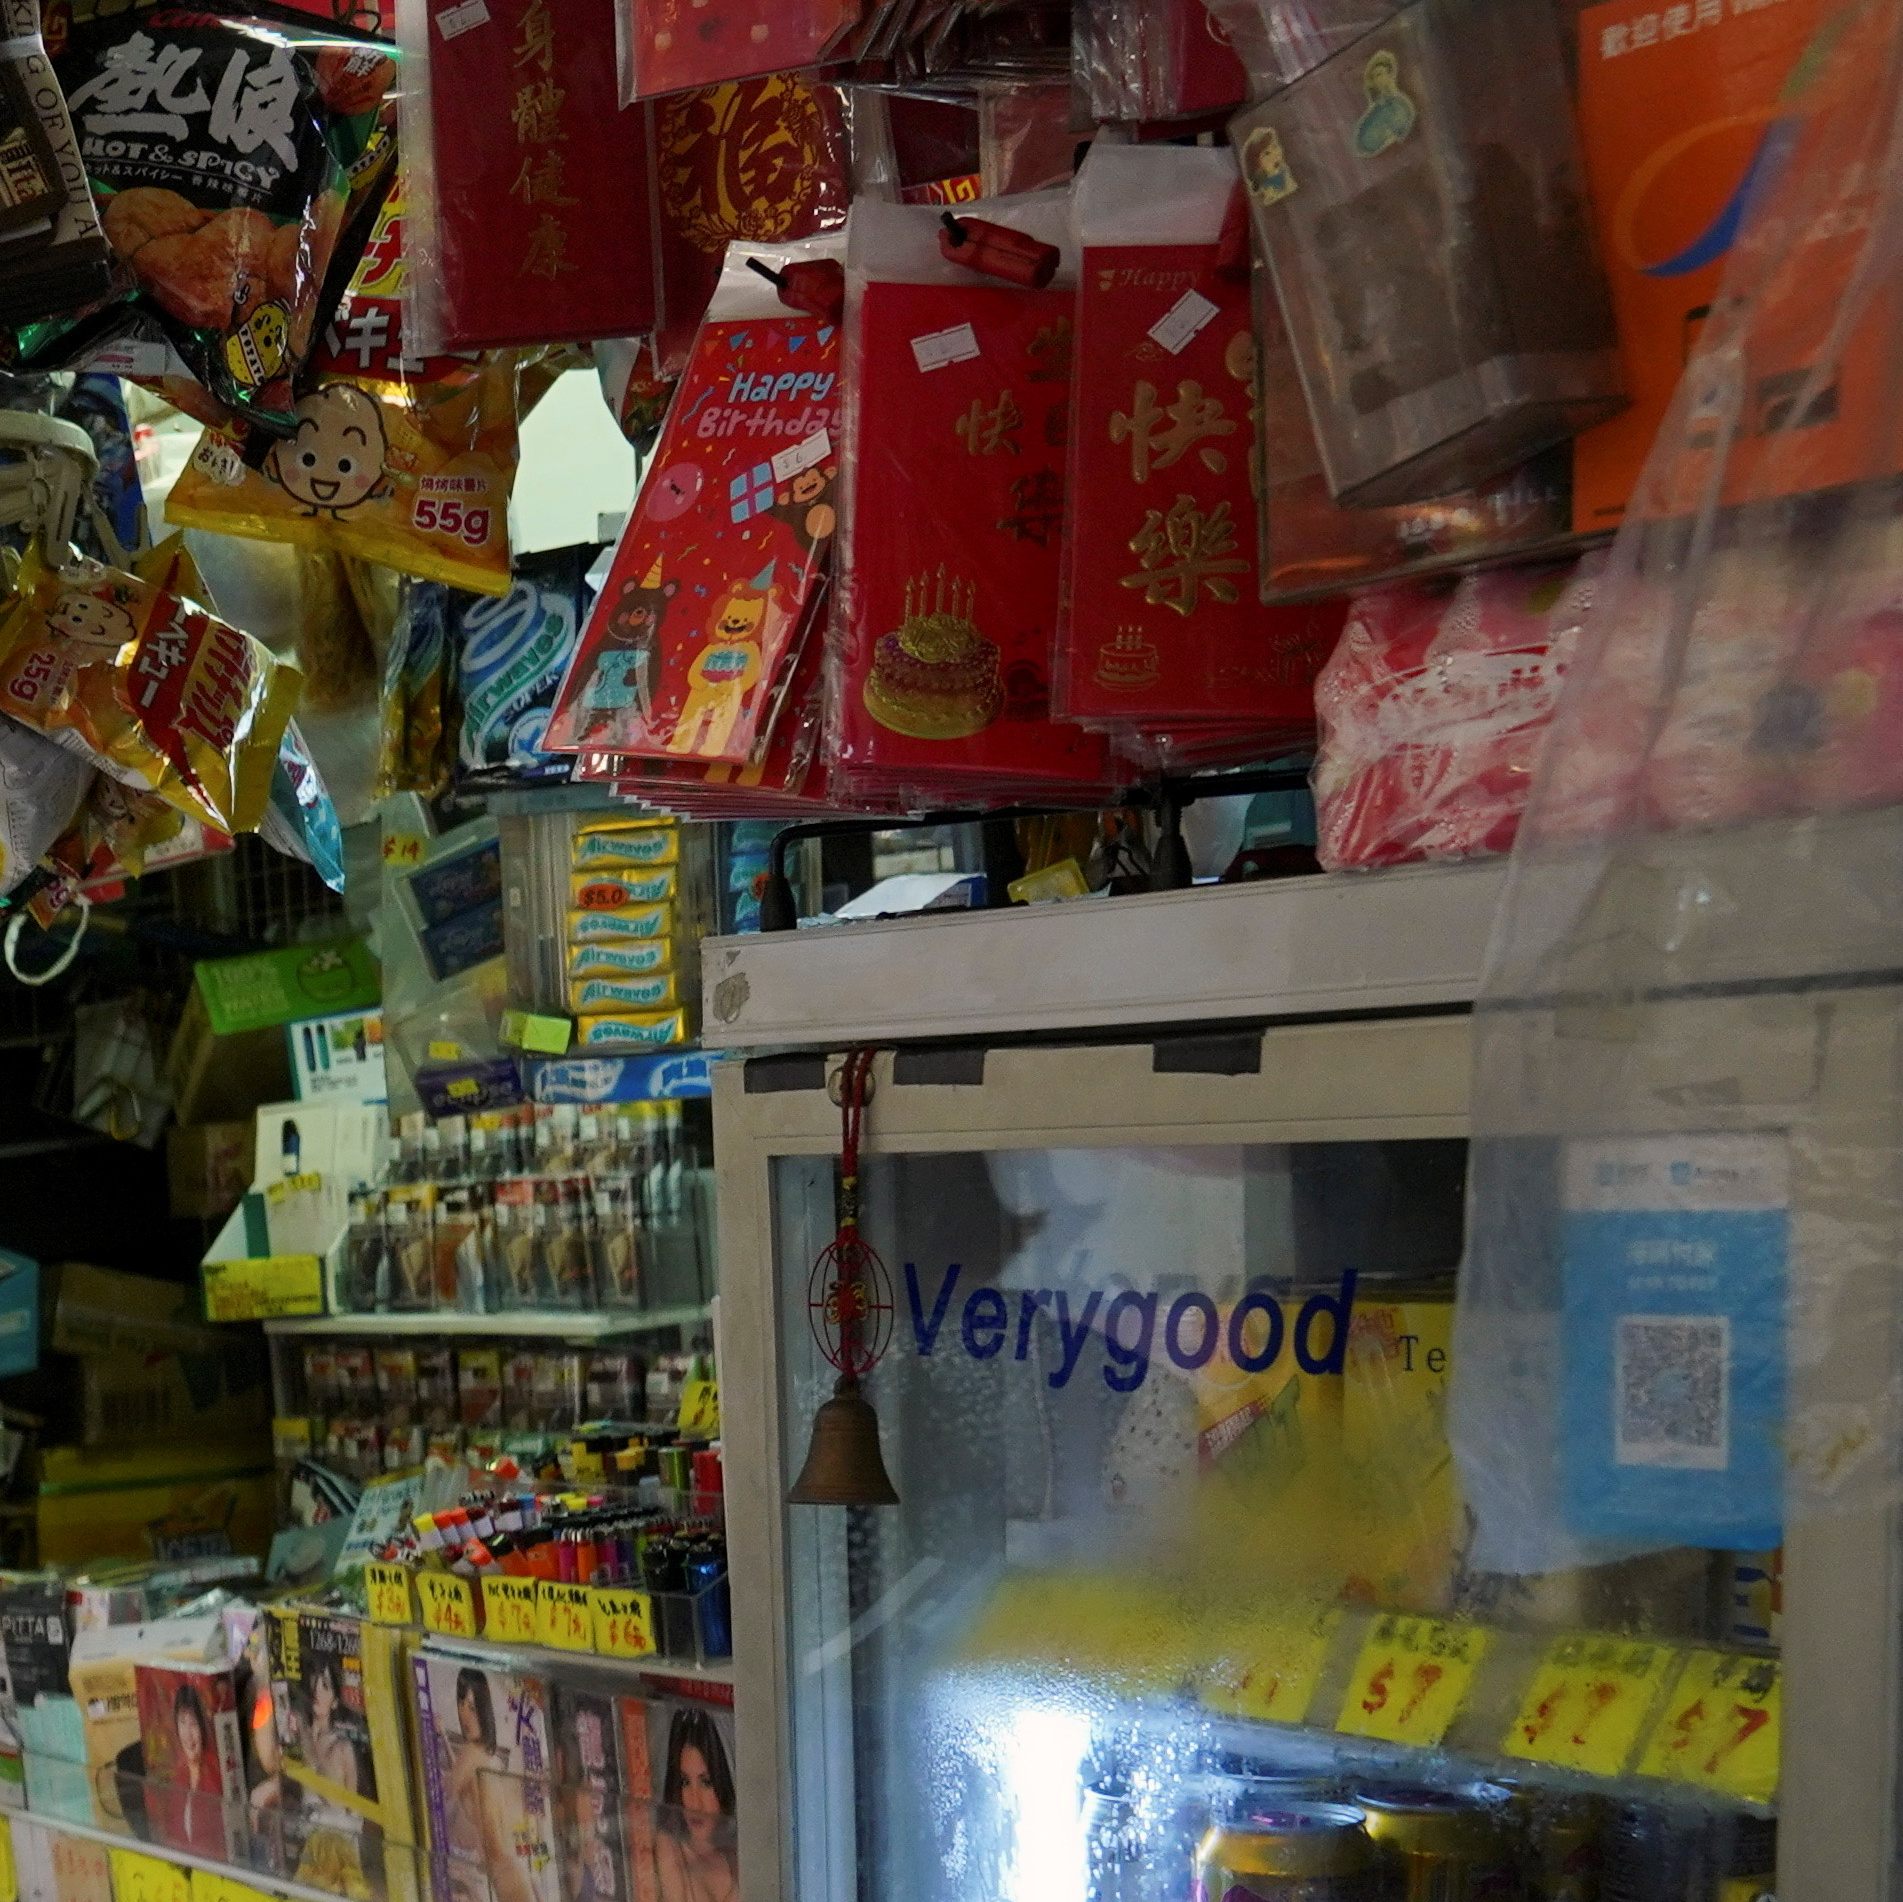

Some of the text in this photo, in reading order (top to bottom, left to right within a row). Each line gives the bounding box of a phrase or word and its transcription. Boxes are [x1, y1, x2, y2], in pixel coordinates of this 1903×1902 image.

[33, 84, 67, 134] OF
[81, 138, 281, 187] HOT & SPICY
[727, 371, 836, 404] Happy
[414, 499, 491, 545] 55g
[1107, 376, 1251, 618] 快樂
[10, 652, 57, 703] 25g
[904, 1264, 1357, 1393] Verygood
